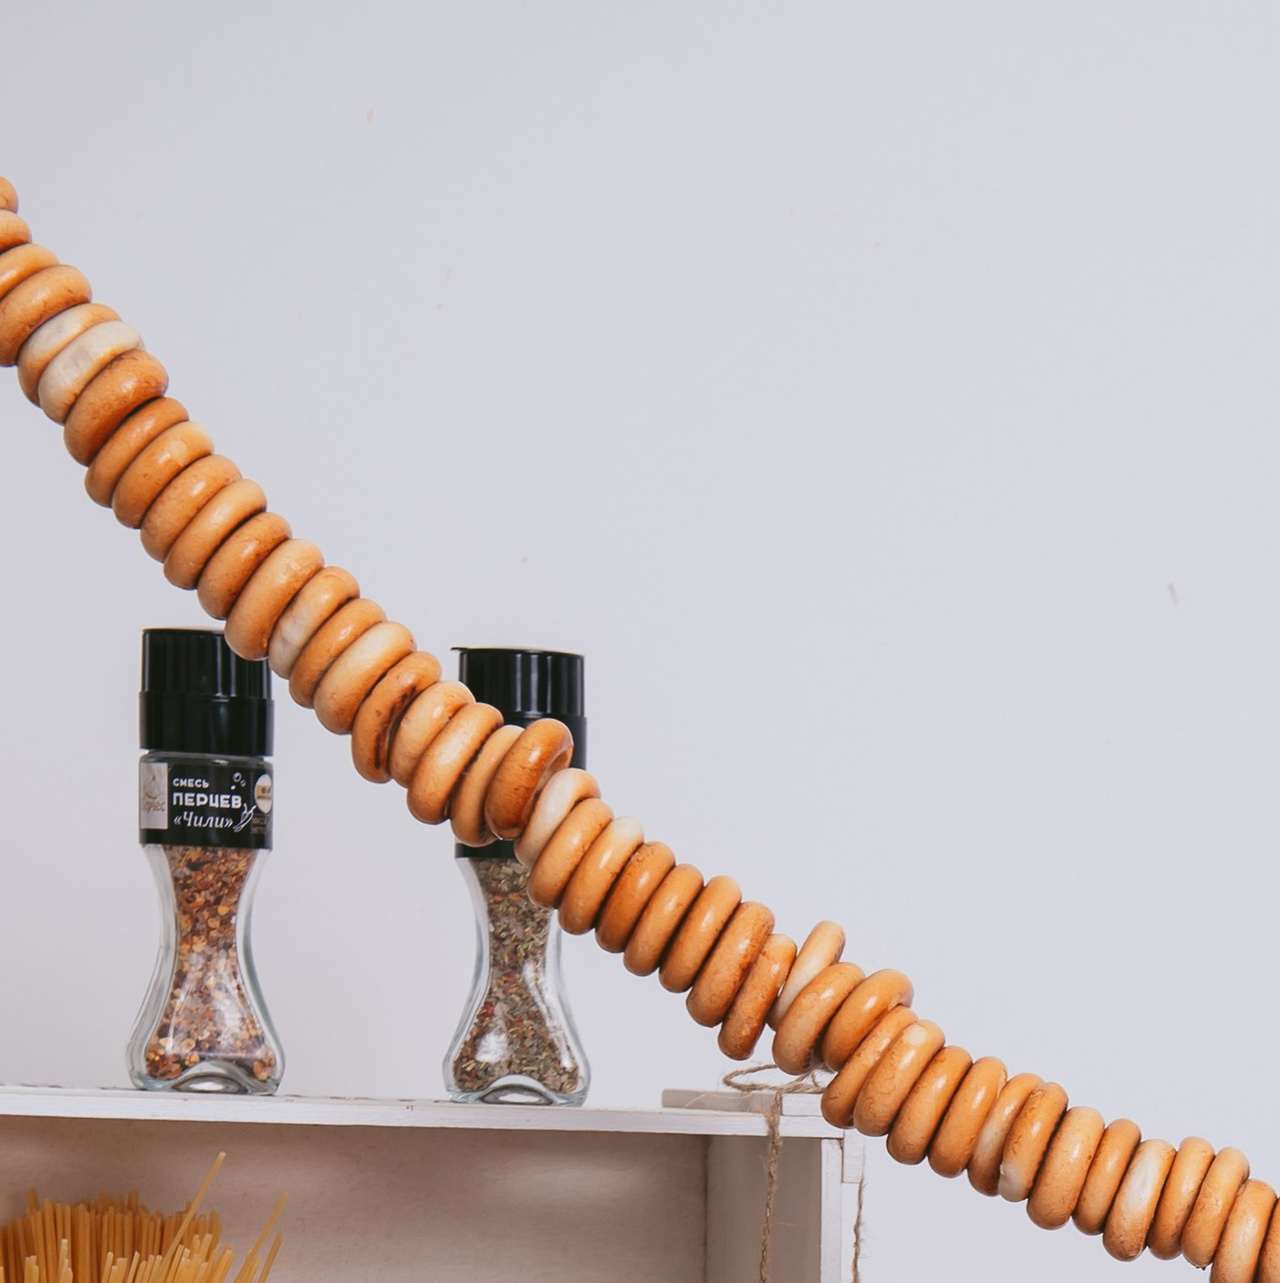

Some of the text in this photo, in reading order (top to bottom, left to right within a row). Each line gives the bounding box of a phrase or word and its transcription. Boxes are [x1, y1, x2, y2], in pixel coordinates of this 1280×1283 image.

[172, 778, 209, 789] СМЕСЬ
[172, 792, 242, 809] ПЕРЦЕВ
[173, 811, 233, 829] «Чили»
